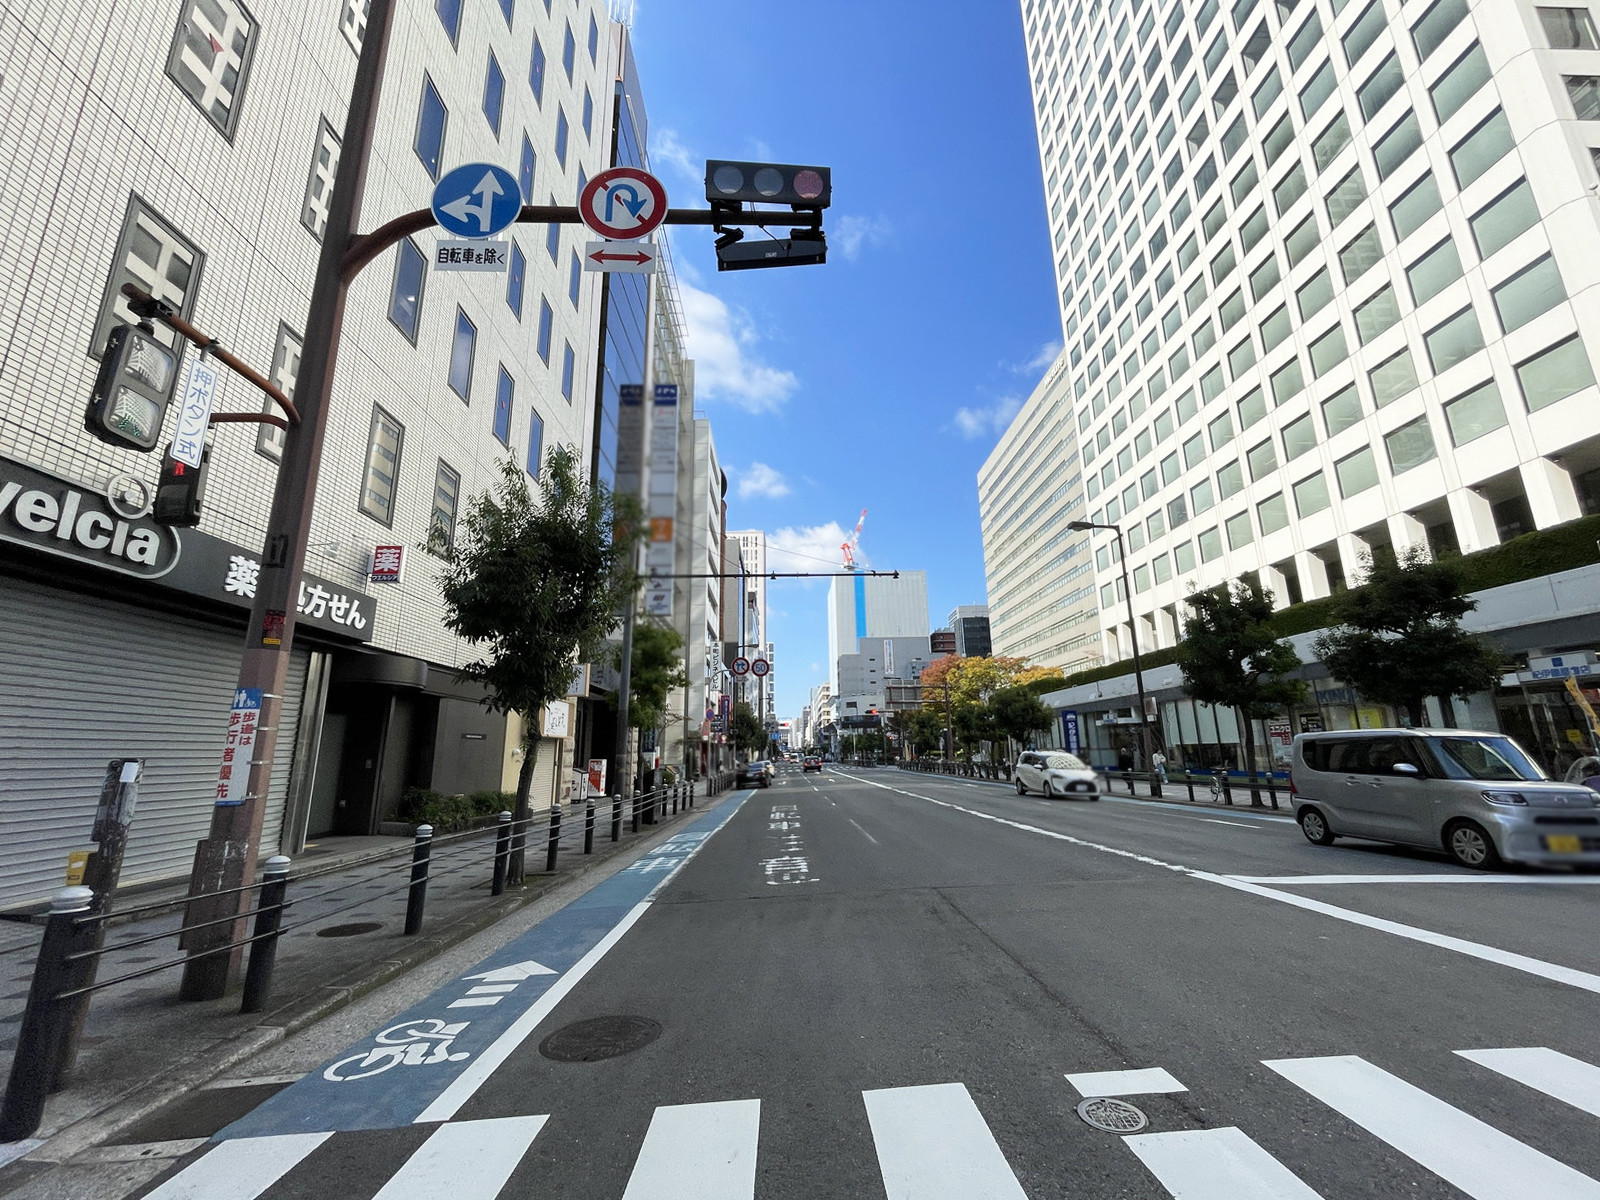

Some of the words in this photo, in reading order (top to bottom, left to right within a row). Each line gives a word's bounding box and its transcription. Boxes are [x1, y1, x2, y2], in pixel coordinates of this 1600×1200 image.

[438, 247, 505, 264] 自転車を除く
[177, 367, 212, 460] 押ボタン式
[0, 474, 161, 566] elcia
[225, 555, 261, 599] 薬
[374, 548, 400, 572] 薬
[755, 663, 766, 672] 50
[238, 711, 257, 746] 歩道は
[216, 711, 241, 799] 歩行者優先
